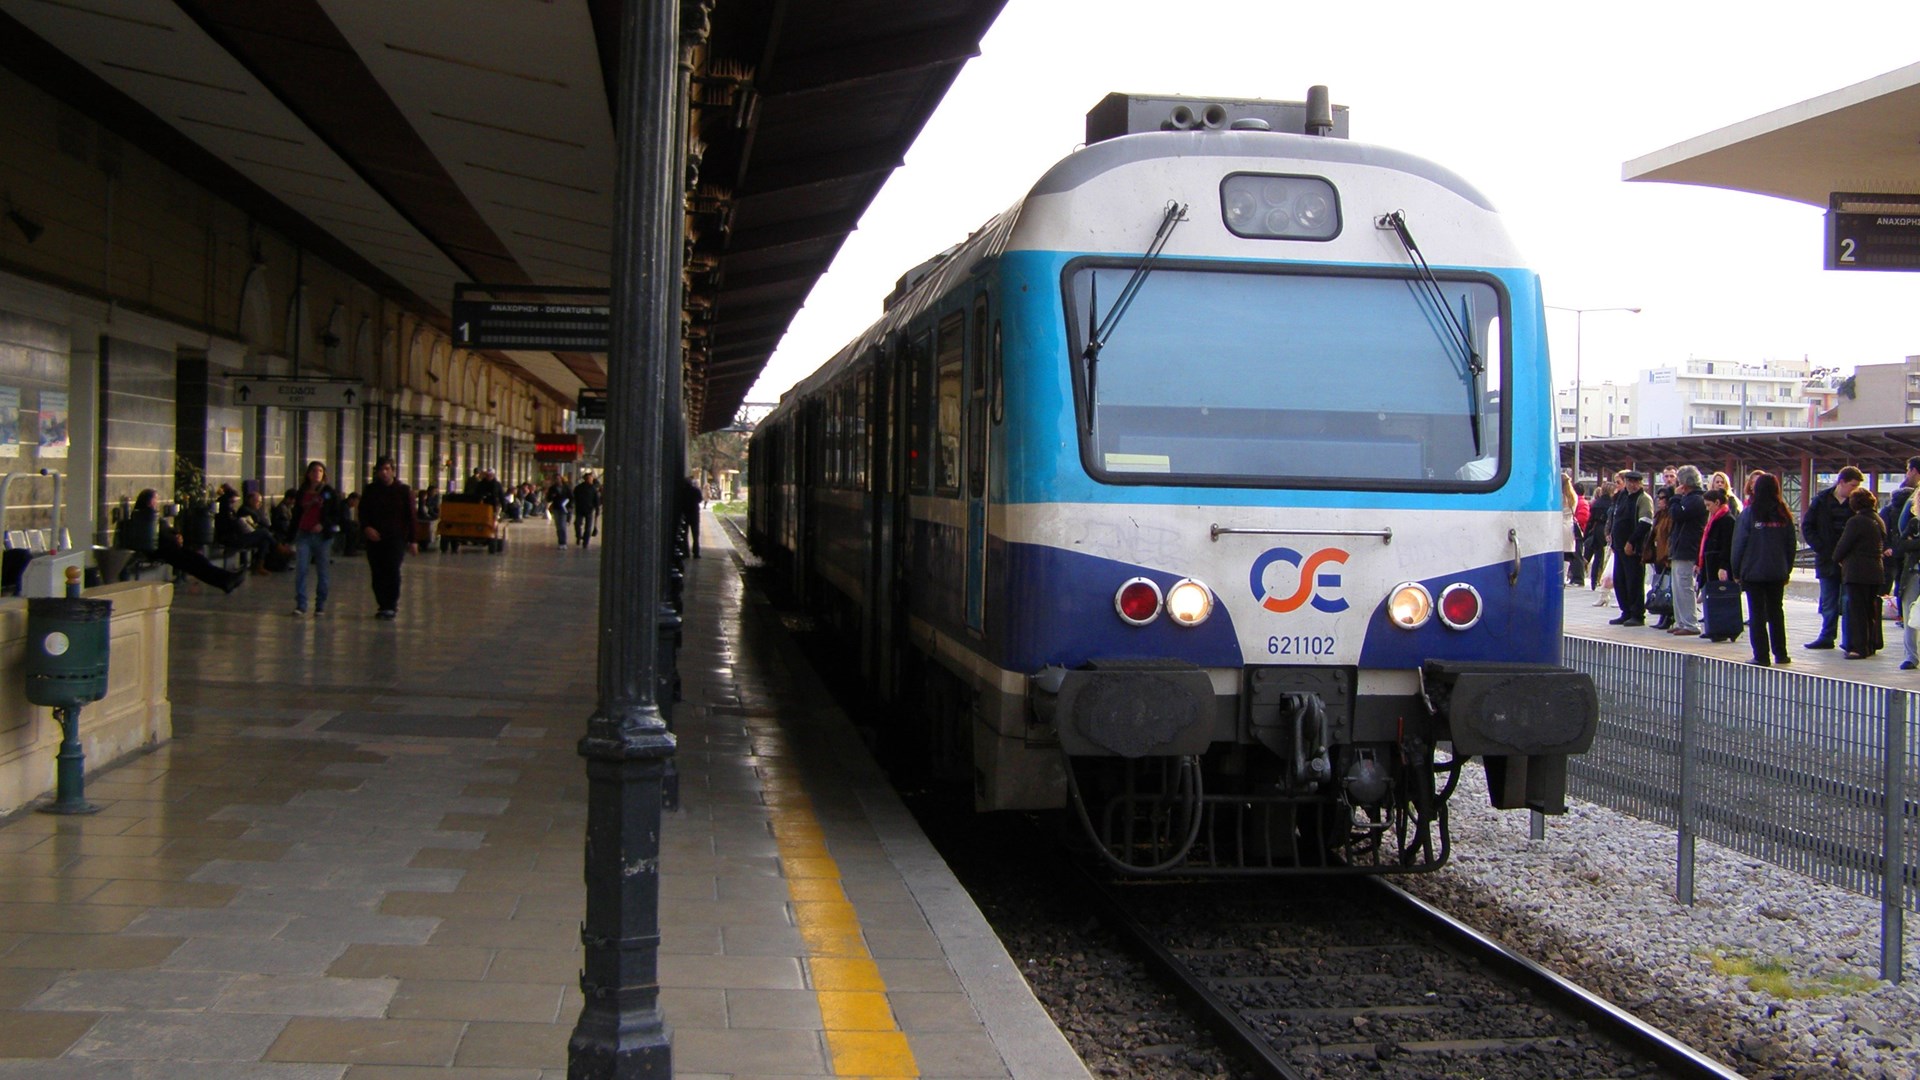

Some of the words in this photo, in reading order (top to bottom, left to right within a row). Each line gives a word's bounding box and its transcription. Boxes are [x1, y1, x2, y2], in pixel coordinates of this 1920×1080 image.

[1840, 238, 1855, 262] 2
[545, 306, 591, 315] DEPARTURE
[459, 322, 470, 342] 1
[279, 386, 317, 395] ΕΞΟΔΟΣ
[1268, 635, 1335, 655] 621102
